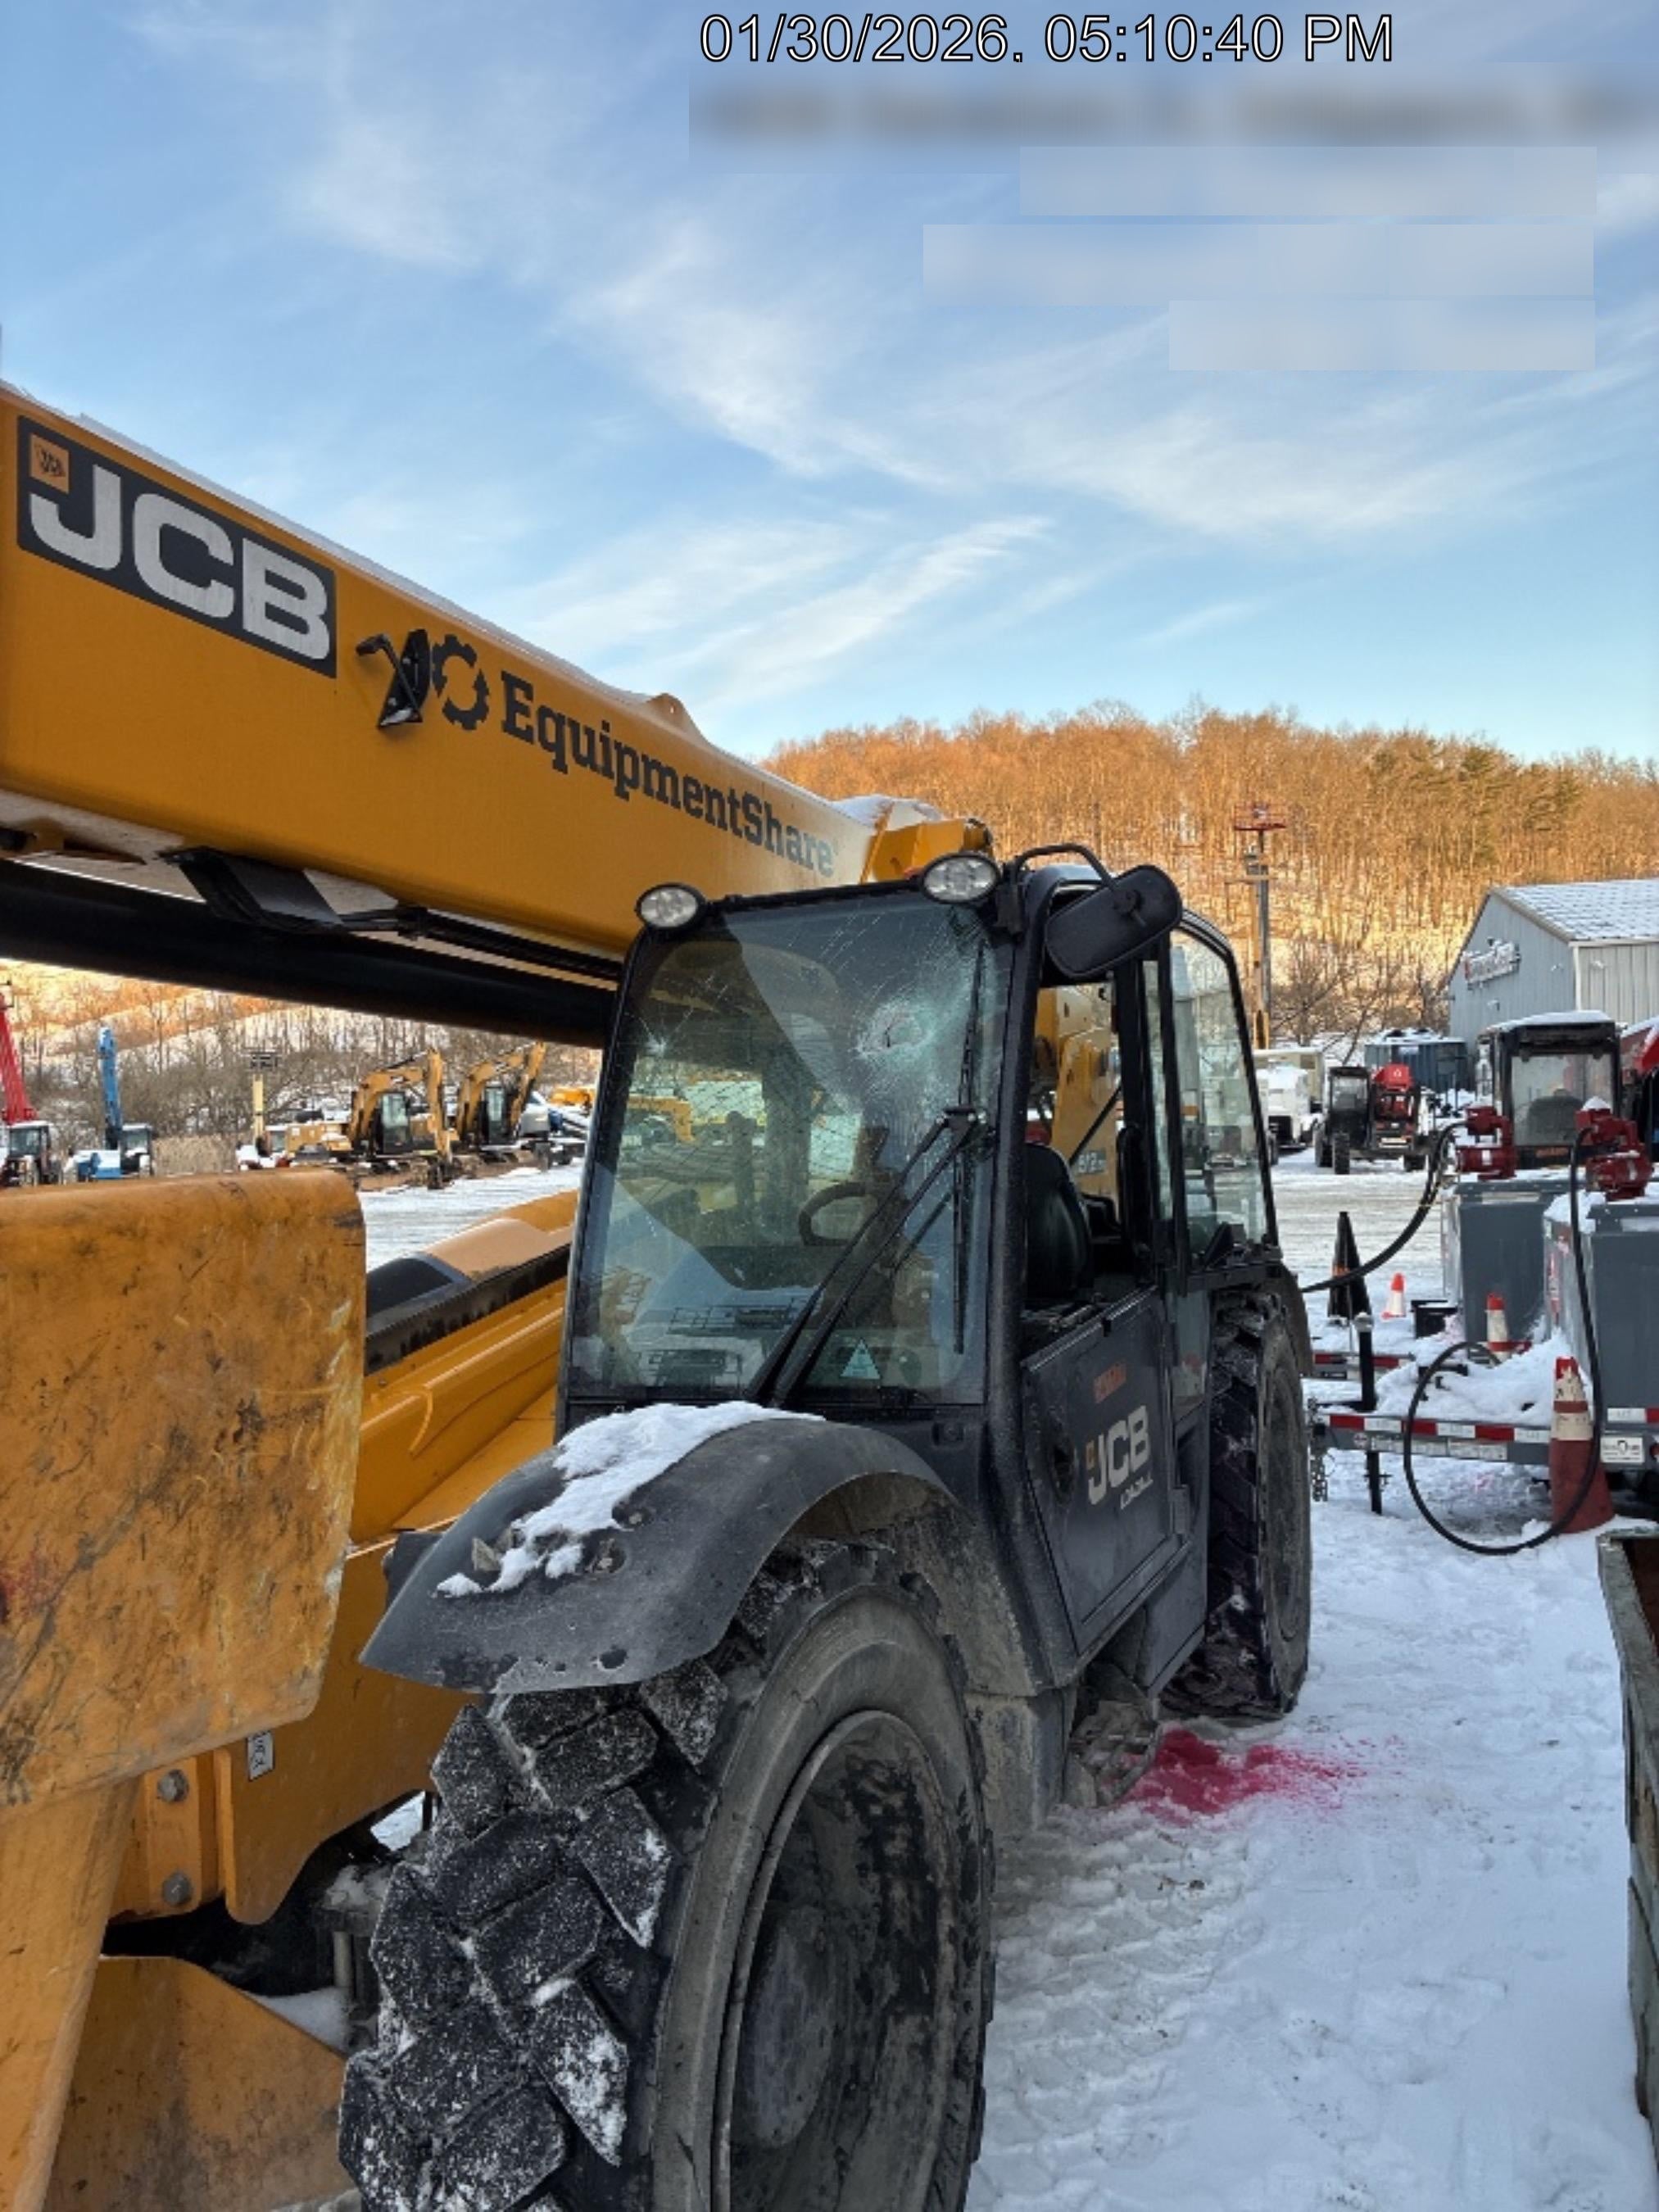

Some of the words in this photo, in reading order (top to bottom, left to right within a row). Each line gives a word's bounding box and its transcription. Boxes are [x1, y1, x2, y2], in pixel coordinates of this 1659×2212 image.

[29, 464, 330, 660] JCB
[501, 669, 835, 877] EquipmentShare
[1088, 1404, 1151, 1505] JCB
